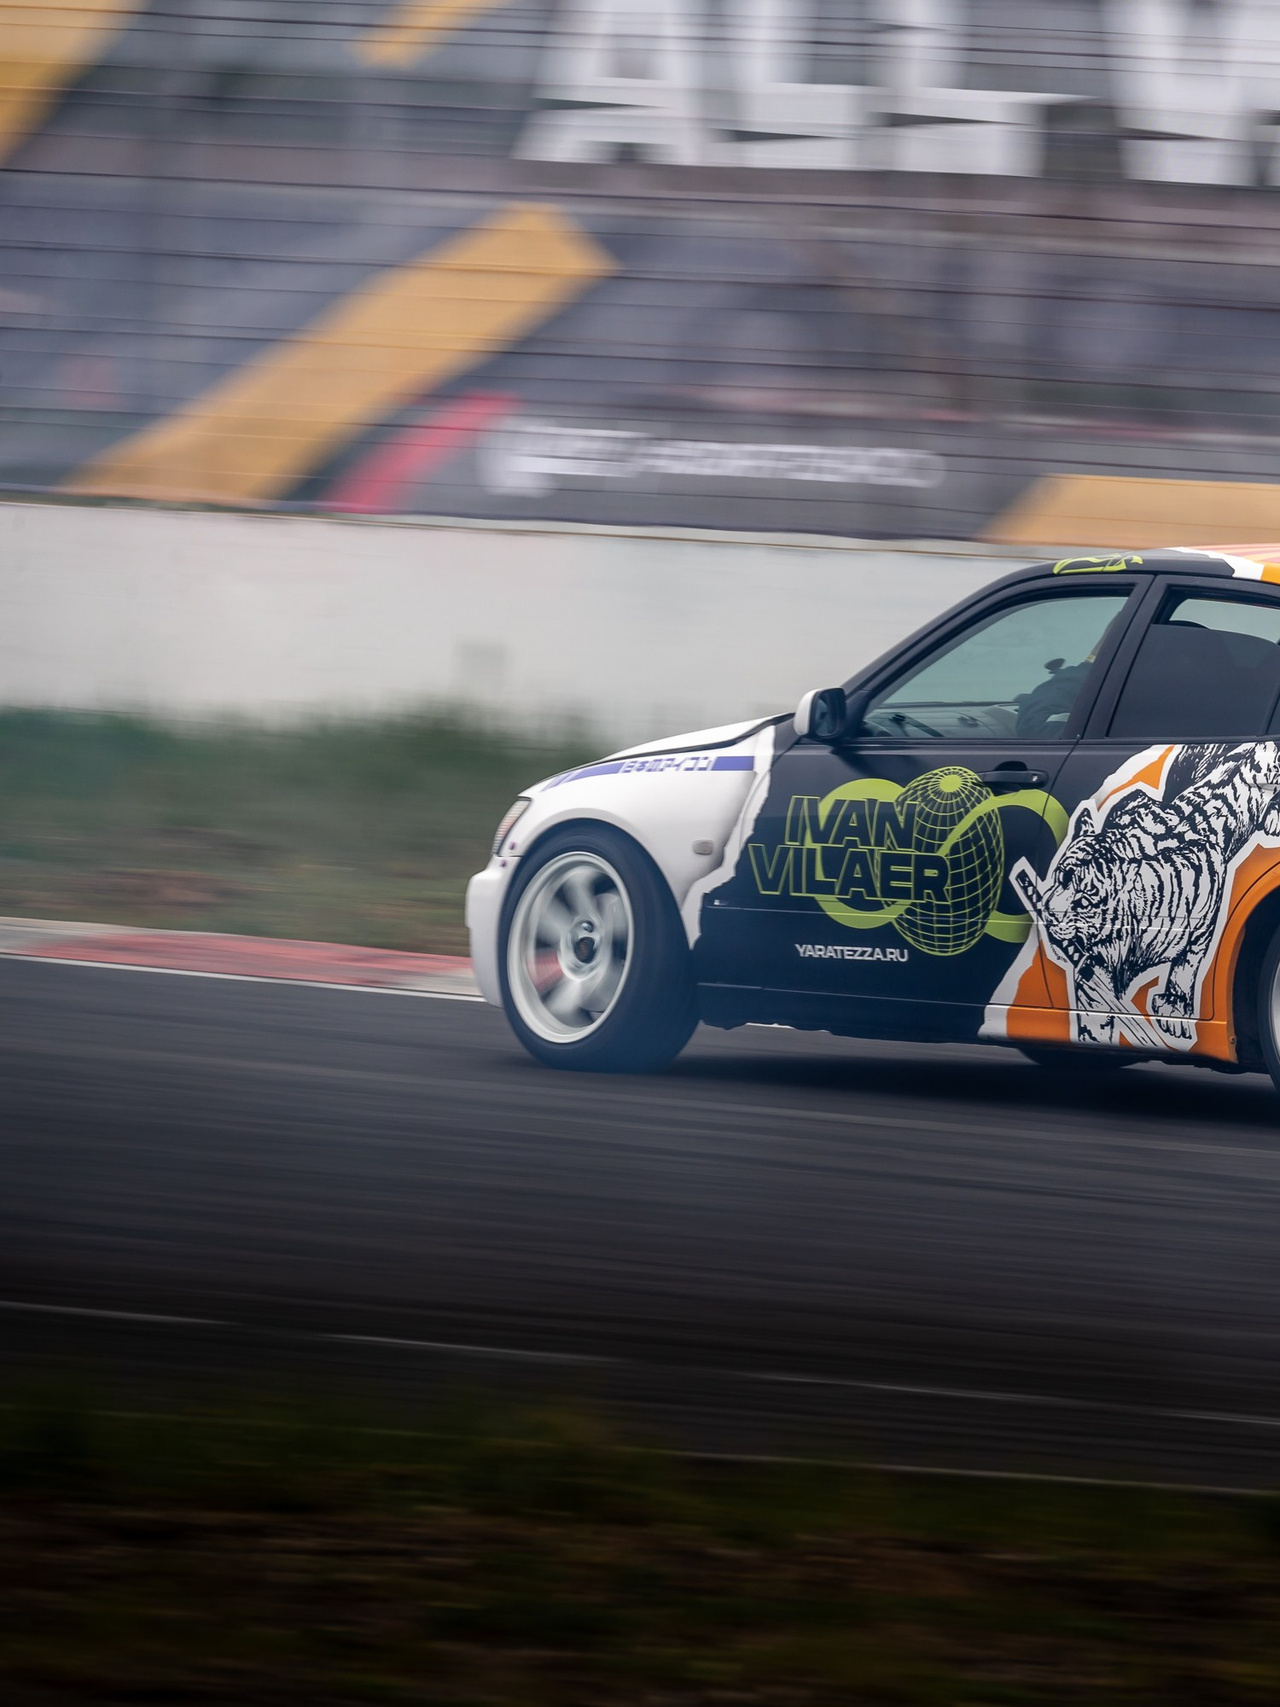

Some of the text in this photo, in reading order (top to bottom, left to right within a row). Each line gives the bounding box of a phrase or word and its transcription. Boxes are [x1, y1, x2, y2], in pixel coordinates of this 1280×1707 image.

[785, 795, 921, 852] IVAN
[748, 843, 950, 904] VILAER
[794, 944, 909, 962] YARATEZZA.RU
